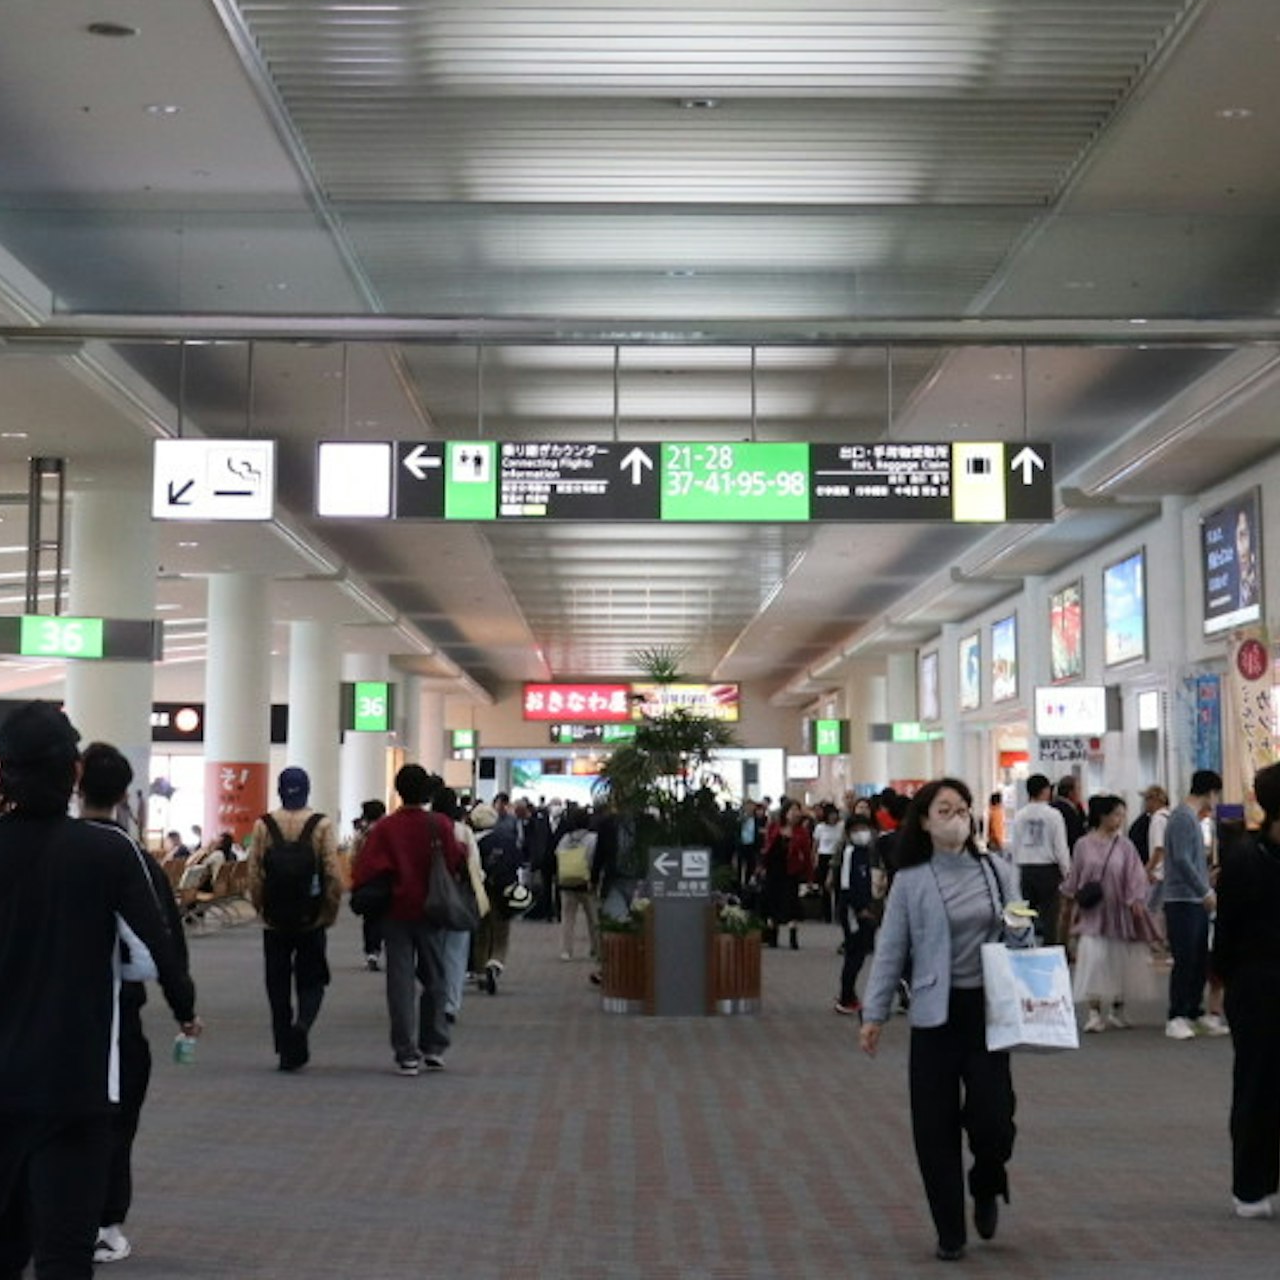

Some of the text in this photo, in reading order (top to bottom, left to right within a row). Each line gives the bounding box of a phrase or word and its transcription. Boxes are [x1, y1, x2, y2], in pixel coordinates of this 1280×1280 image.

[667, 445, 733, 469] 21-28
[38, 621, 84, 654] 36
[359, 697, 384, 716] 36
[525, 690, 628, 713] おきなわ屋
